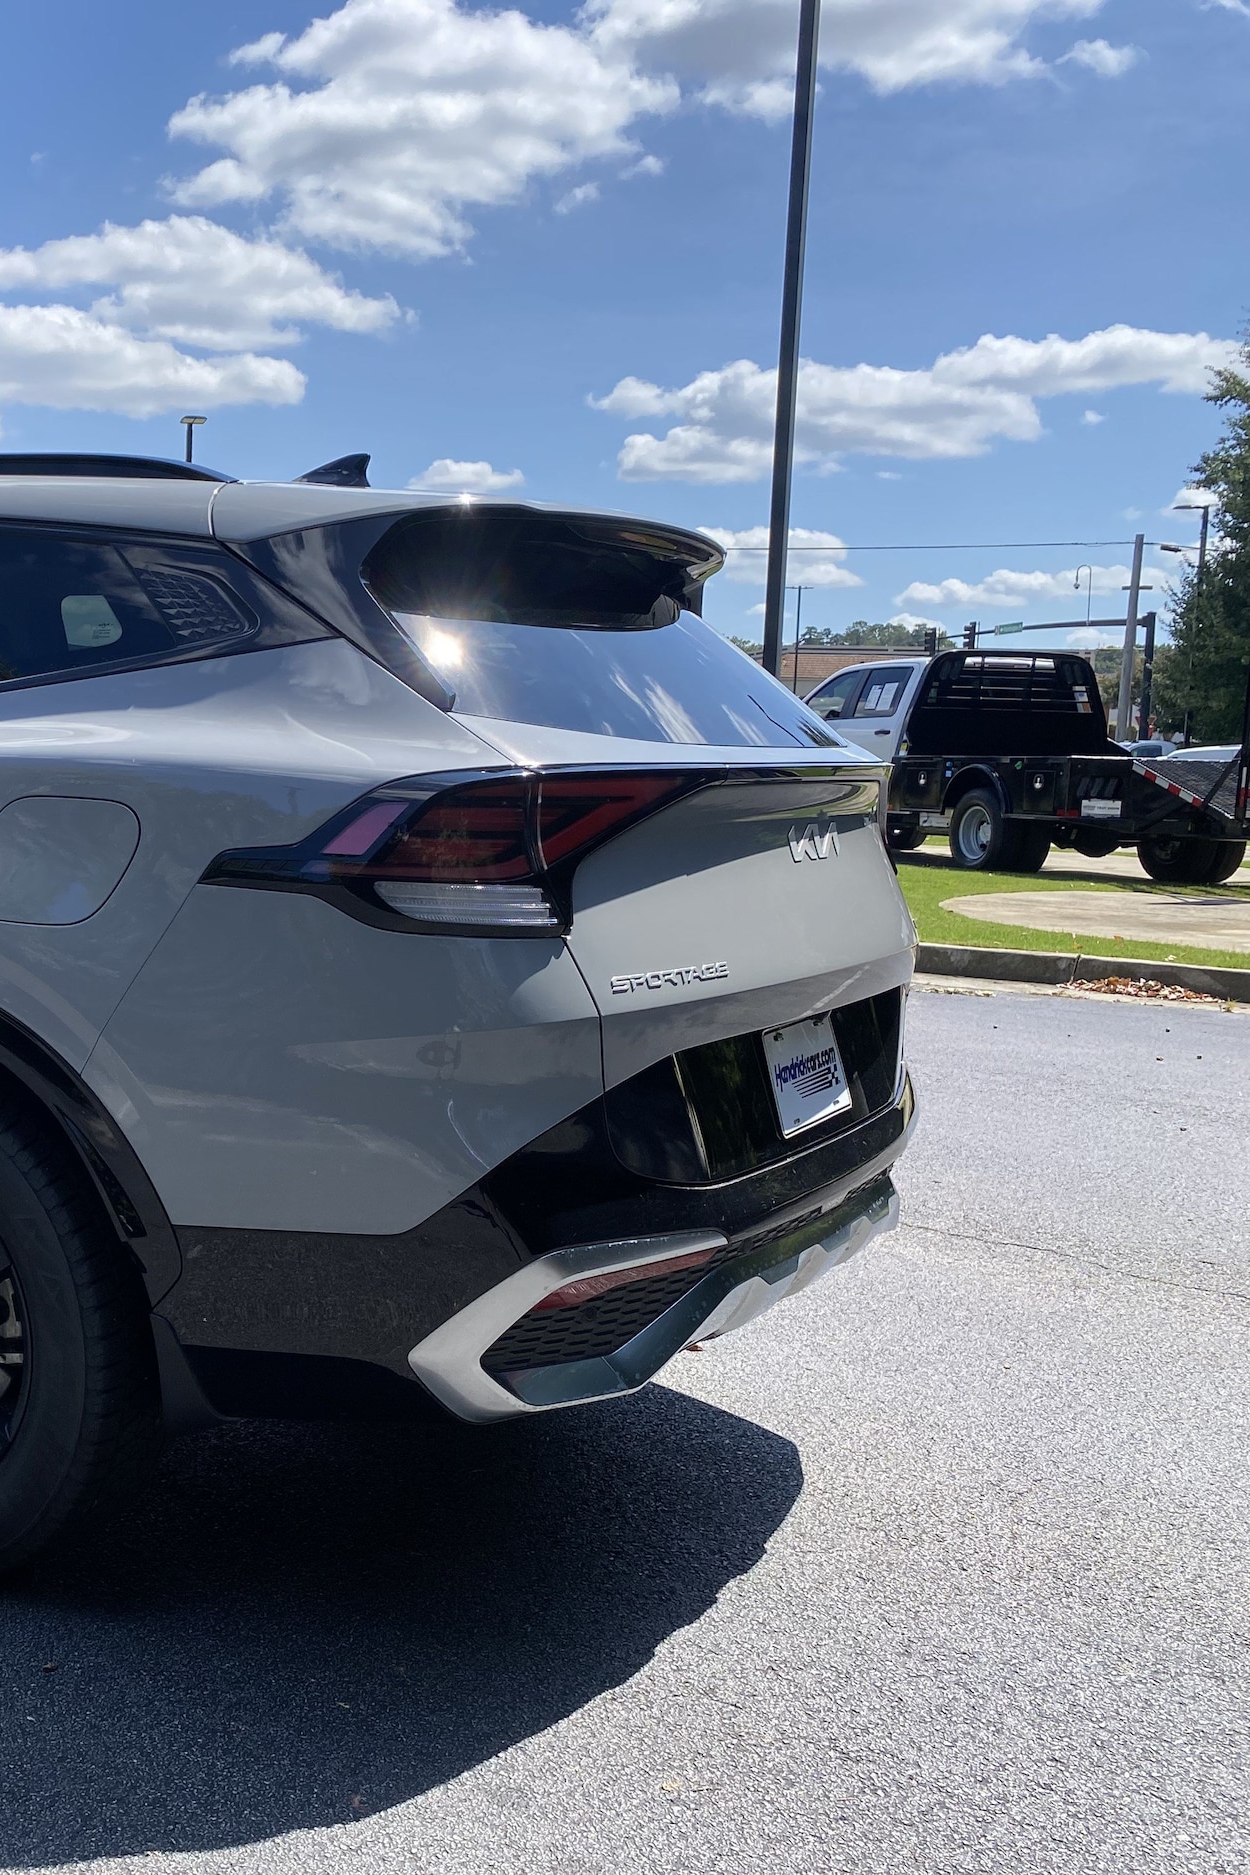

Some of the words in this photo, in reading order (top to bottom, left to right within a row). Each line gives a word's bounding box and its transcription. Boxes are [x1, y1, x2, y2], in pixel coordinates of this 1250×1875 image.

[787, 821, 841, 864] KIA
[610, 961, 730, 995] SPORTAGE
[774, 1046, 837, 1093] Hendrickcars.com
